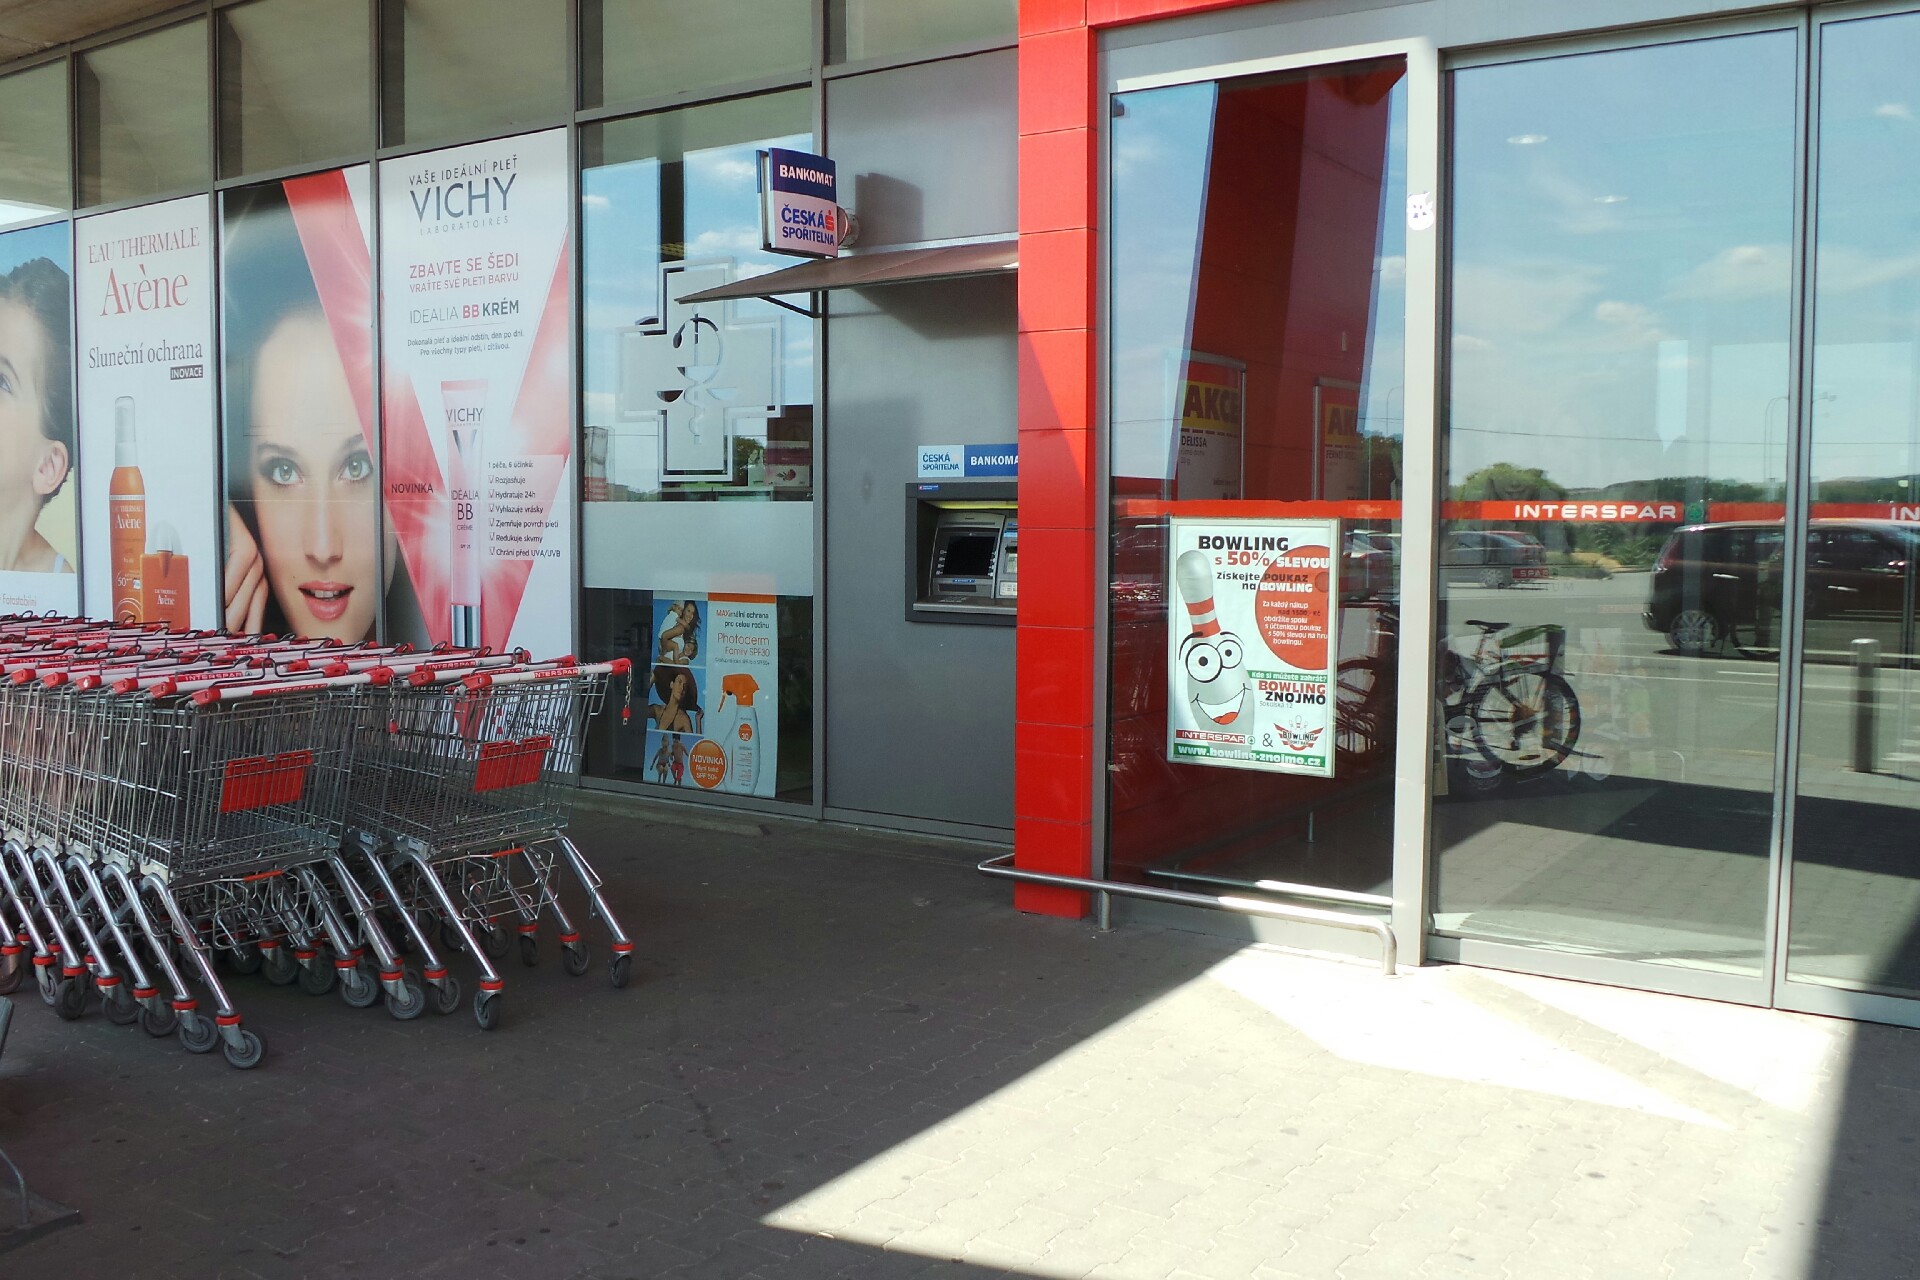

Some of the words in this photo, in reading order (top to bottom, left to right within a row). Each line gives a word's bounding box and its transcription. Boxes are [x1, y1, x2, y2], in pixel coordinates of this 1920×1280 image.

[408, 170, 436, 186] VAŠE
[441, 160, 487, 180] IDEÁLNÍ
[492, 154, 518, 172] PLEŤ
[779, 164, 834, 187] BANKOMAT
[409, 173, 517, 223] VICHY
[781, 203, 825, 229] ČESKÁ
[420, 216, 509, 236] LABORATOIRES
[782, 226, 835, 246] SPOŘITELNA
[88, 241, 115, 264] EAU
[118, 227, 200, 258] THERMALE
[409, 260, 461, 279] ZBAVTE
[466, 257, 483, 272] SE
[487, 252, 519, 269] ŠEDI
[100, 264, 188, 316] Avène
[409, 280, 442, 293] VRAŤTE
[444, 276, 460, 289] SVÉ
[463, 275, 485, 287] PLETI
[488, 272, 519, 285] BARVU
[409, 306, 459, 324] IDEALIA
[462, 304, 480, 319] BB
[482, 297, 519, 317] KRÉM
[89, 342, 144, 369] Sluneční
[147, 339, 203, 363] ochrana
[420, 348, 430, 356] Pro
[171, 366, 203, 380] INOVACE
[445, 408, 483, 422] VICHY
[922, 452, 950, 462] ČESKÁ
[970, 455, 1018, 466] BANKOMA
[922, 463, 959, 471] SPOŘITELNA
[391, 483, 434, 494] NOVINKA
[524, 490, 535, 498] 24h
[457, 503, 474, 520] BB
[1514, 504, 1676, 519] INTERSPAR
[1198, 535, 1289, 551] BOWLING
[1215, 556, 1222, 565] s
[1227, 551, 1270, 567] 50%
[1276, 556, 1330, 569] SLEVOU
[1216, 572, 1260, 582] Získejte
[1264, 572, 1308, 583] POUKAZ
[1242, 582, 1256, 590] na
[1259, 582, 1313, 593] BOWLING
[1289, 601, 1308, 609] nákup
[717, 633, 770, 645] Photoderm
[1273, 638, 1304, 646] bowlingu.
[1251, 671, 1264, 679] Kde
[1272, 672, 1299, 681] můžete
[1300, 674, 1327, 682] zahrát?
[1258, 680, 1326, 695] BOWLING
[1265, 691, 1326, 705] ZNOJMO
[1181, 731, 1245, 744] INTERSPAR
[1282, 731, 1315, 741] BOWLING
[692, 754, 724, 765] NOVINKA
[1177, 745, 1321, 767] www.bowling-znojmo.cz
